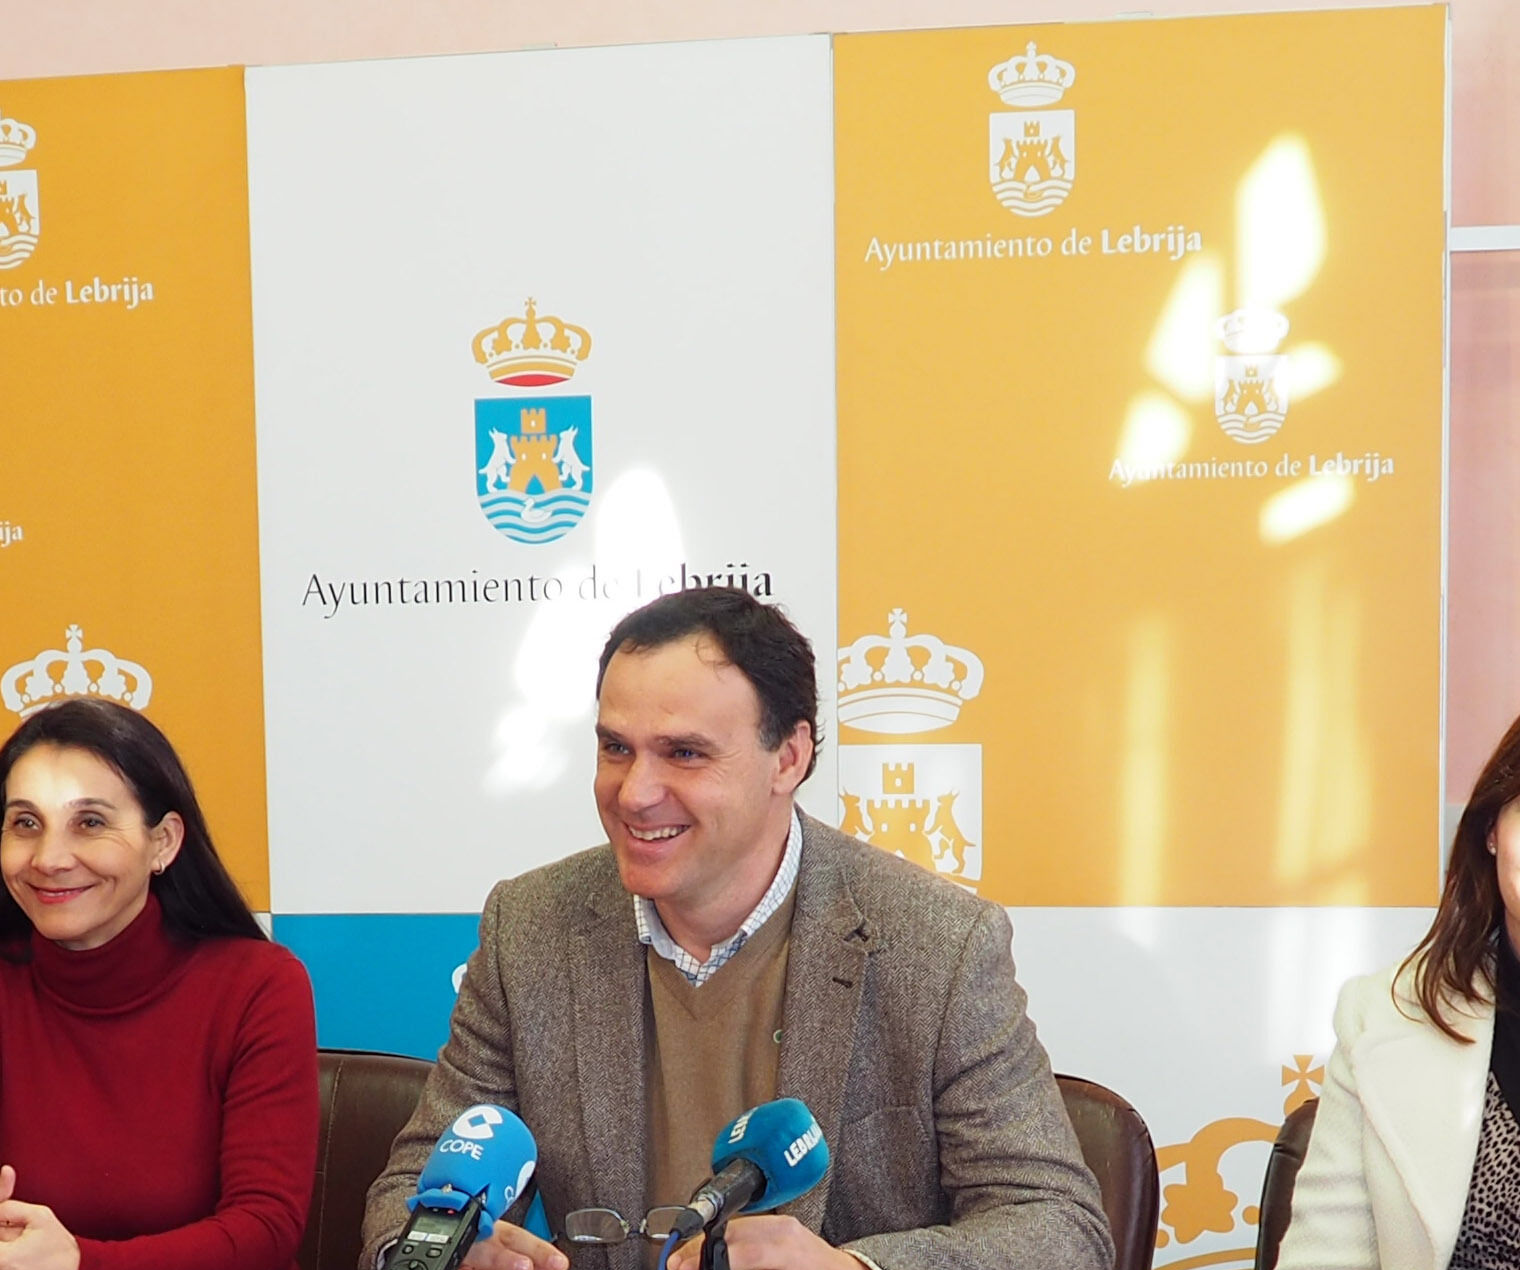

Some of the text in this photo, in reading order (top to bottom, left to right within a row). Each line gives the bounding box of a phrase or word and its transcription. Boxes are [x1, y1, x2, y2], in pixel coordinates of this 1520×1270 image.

[864, 224, 1202, 270] Ayuntamiento de Lebrija
[30, 280, 58, 306] de
[65, 277, 155, 310] Lebrija
[1108, 452, 1394, 488] Ayuntamiento de Lebrija
[302, 570, 563, 620] Ayuntamiento
[439, 1138, 485, 1161] COPE
